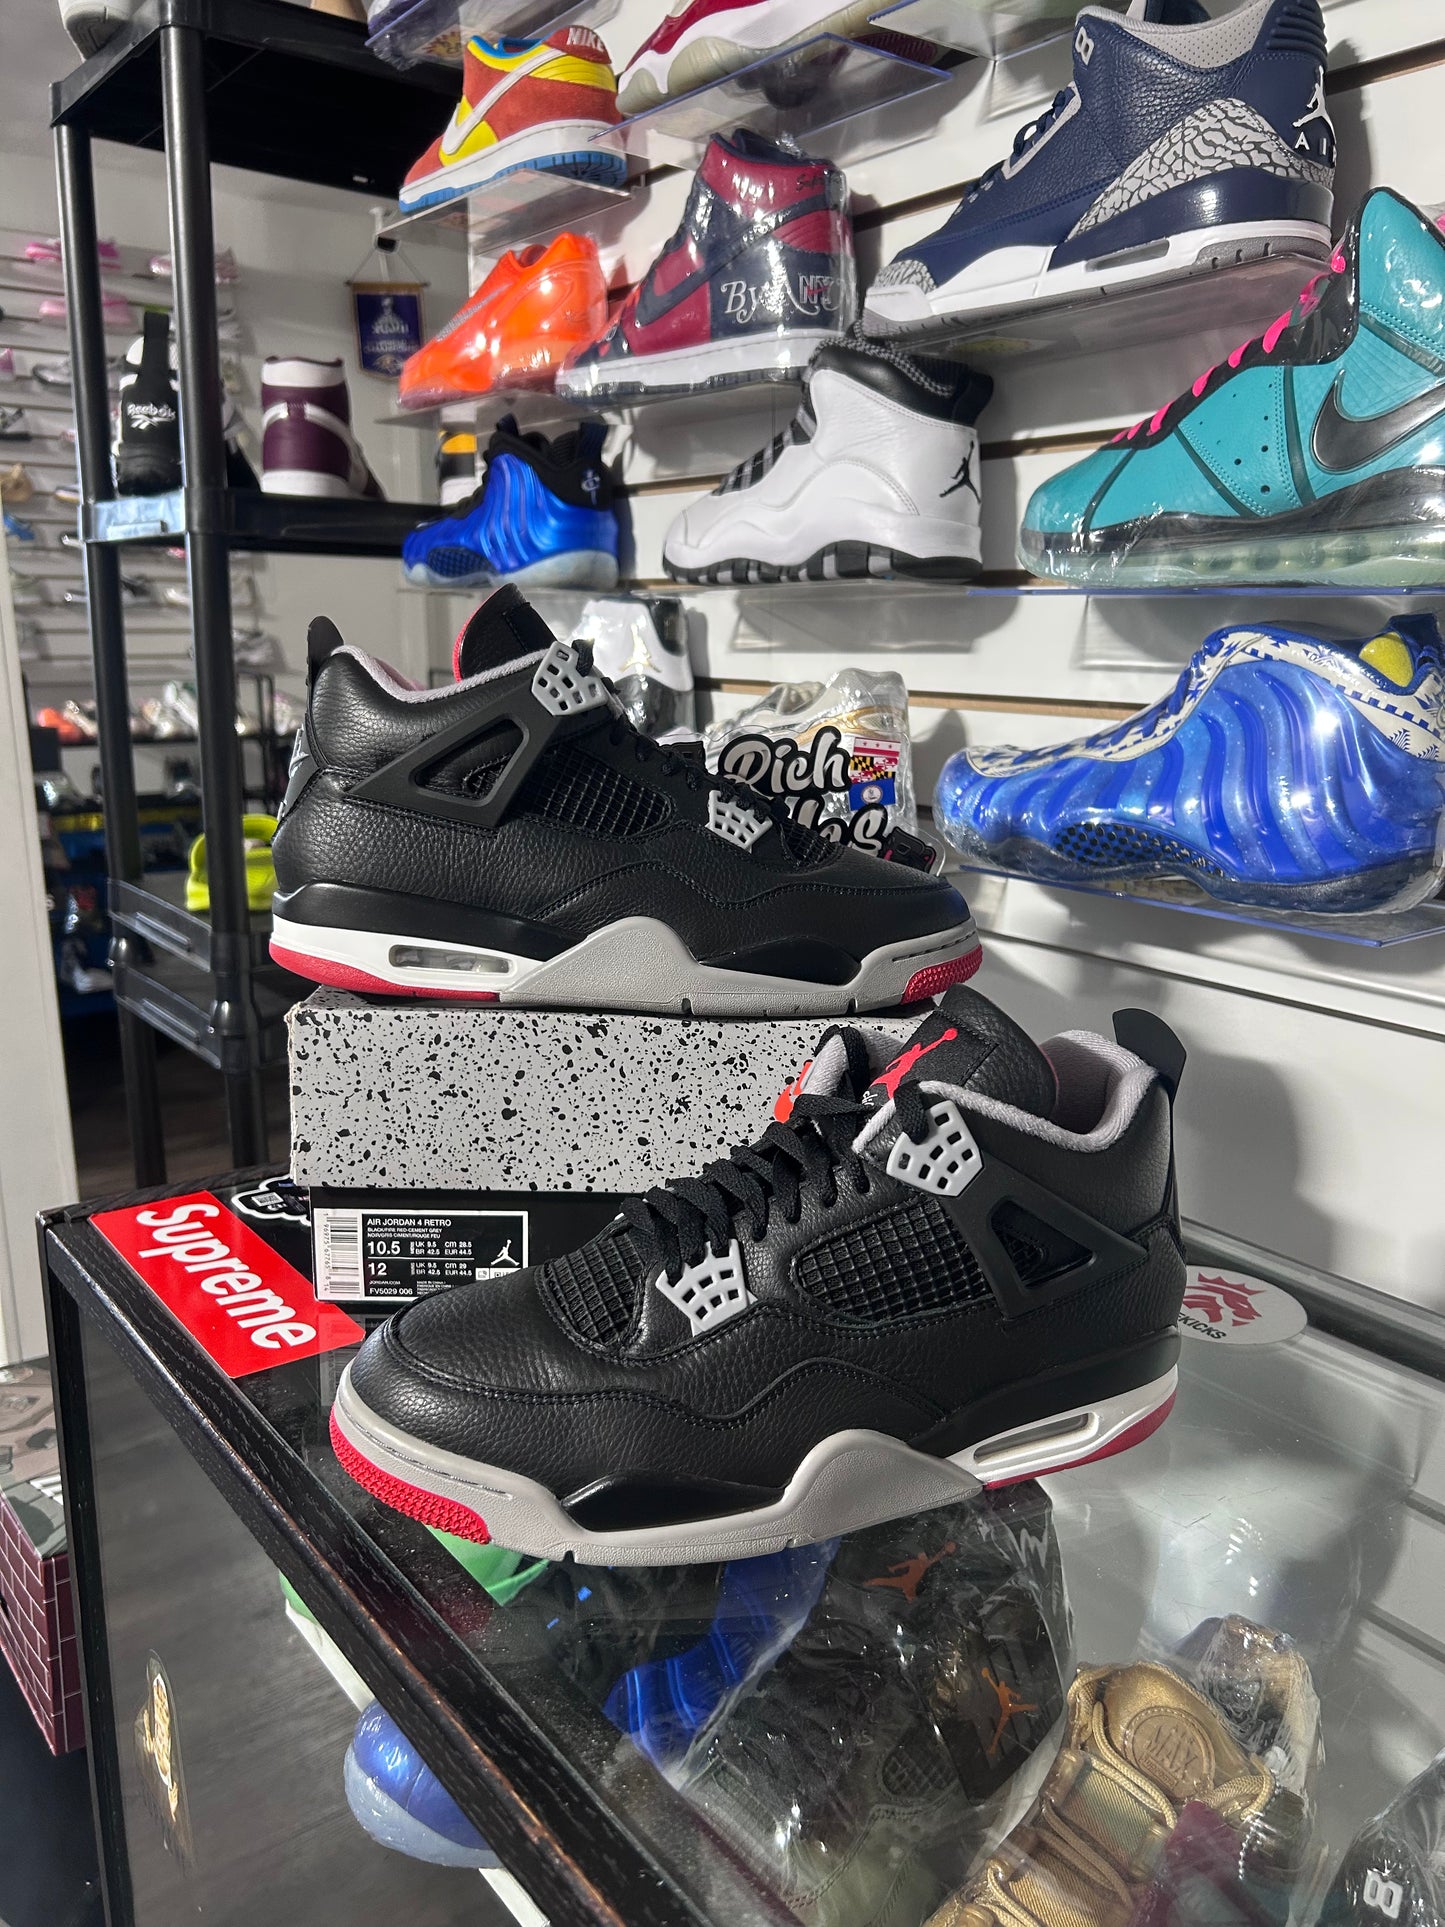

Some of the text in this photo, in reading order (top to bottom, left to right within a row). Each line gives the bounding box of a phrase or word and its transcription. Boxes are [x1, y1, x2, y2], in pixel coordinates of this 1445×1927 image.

[566, 27, 604, 52] NIKE
[127, 402, 176, 419] Reebok
[719, 727, 850, 799] Rich
[366, 1218, 381, 1226] AIR
[382, 1218, 416, 1226] JORDAN
[424, 1219, 452, 1227] RETRO
[367, 1241, 401, 1255] 10.5
[136, 1203, 317, 1349] Supreme
[368, 1262, 387, 1276] 12
